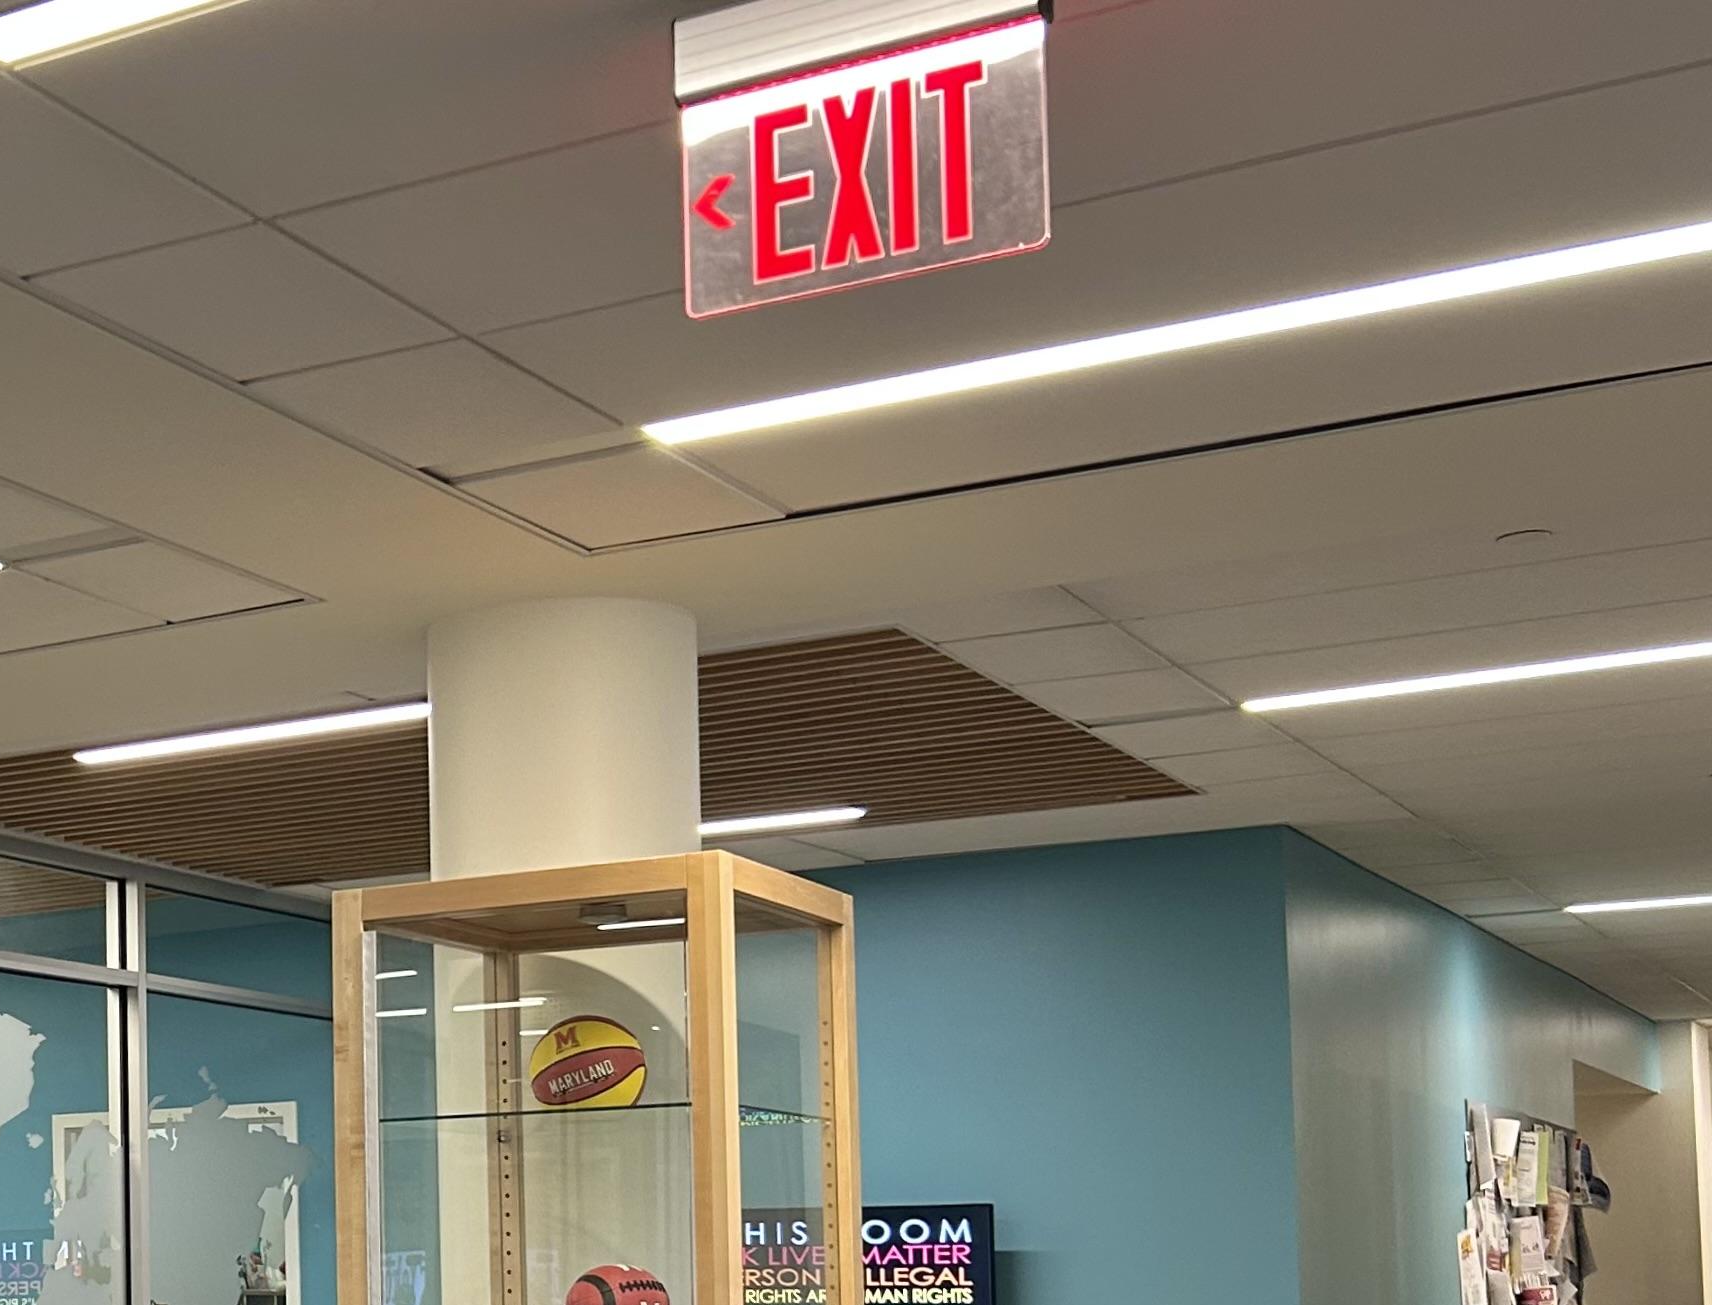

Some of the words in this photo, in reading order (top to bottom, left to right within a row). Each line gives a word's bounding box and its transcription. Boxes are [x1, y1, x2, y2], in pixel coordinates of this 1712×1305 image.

[753, 60, 987, 284] EXIT
[554, 1025, 581, 1053] M
[548, 1059, 615, 1095] MARYLAND
[745, 1221, 808, 1246] HIS
[861, 1218, 973, 1244] OOM
[768, 1246, 825, 1266] LIVE
[745, 1268, 822, 1287] RSON
[866, 1266, 974, 1287] LLEGAL
[745, 1289, 802, 1304] RIGHTS
[806, 1289, 827, 1304] AR
[864, 1288, 909, 1304] MAN
[911, 1287, 974, 1304] RIGHTS
